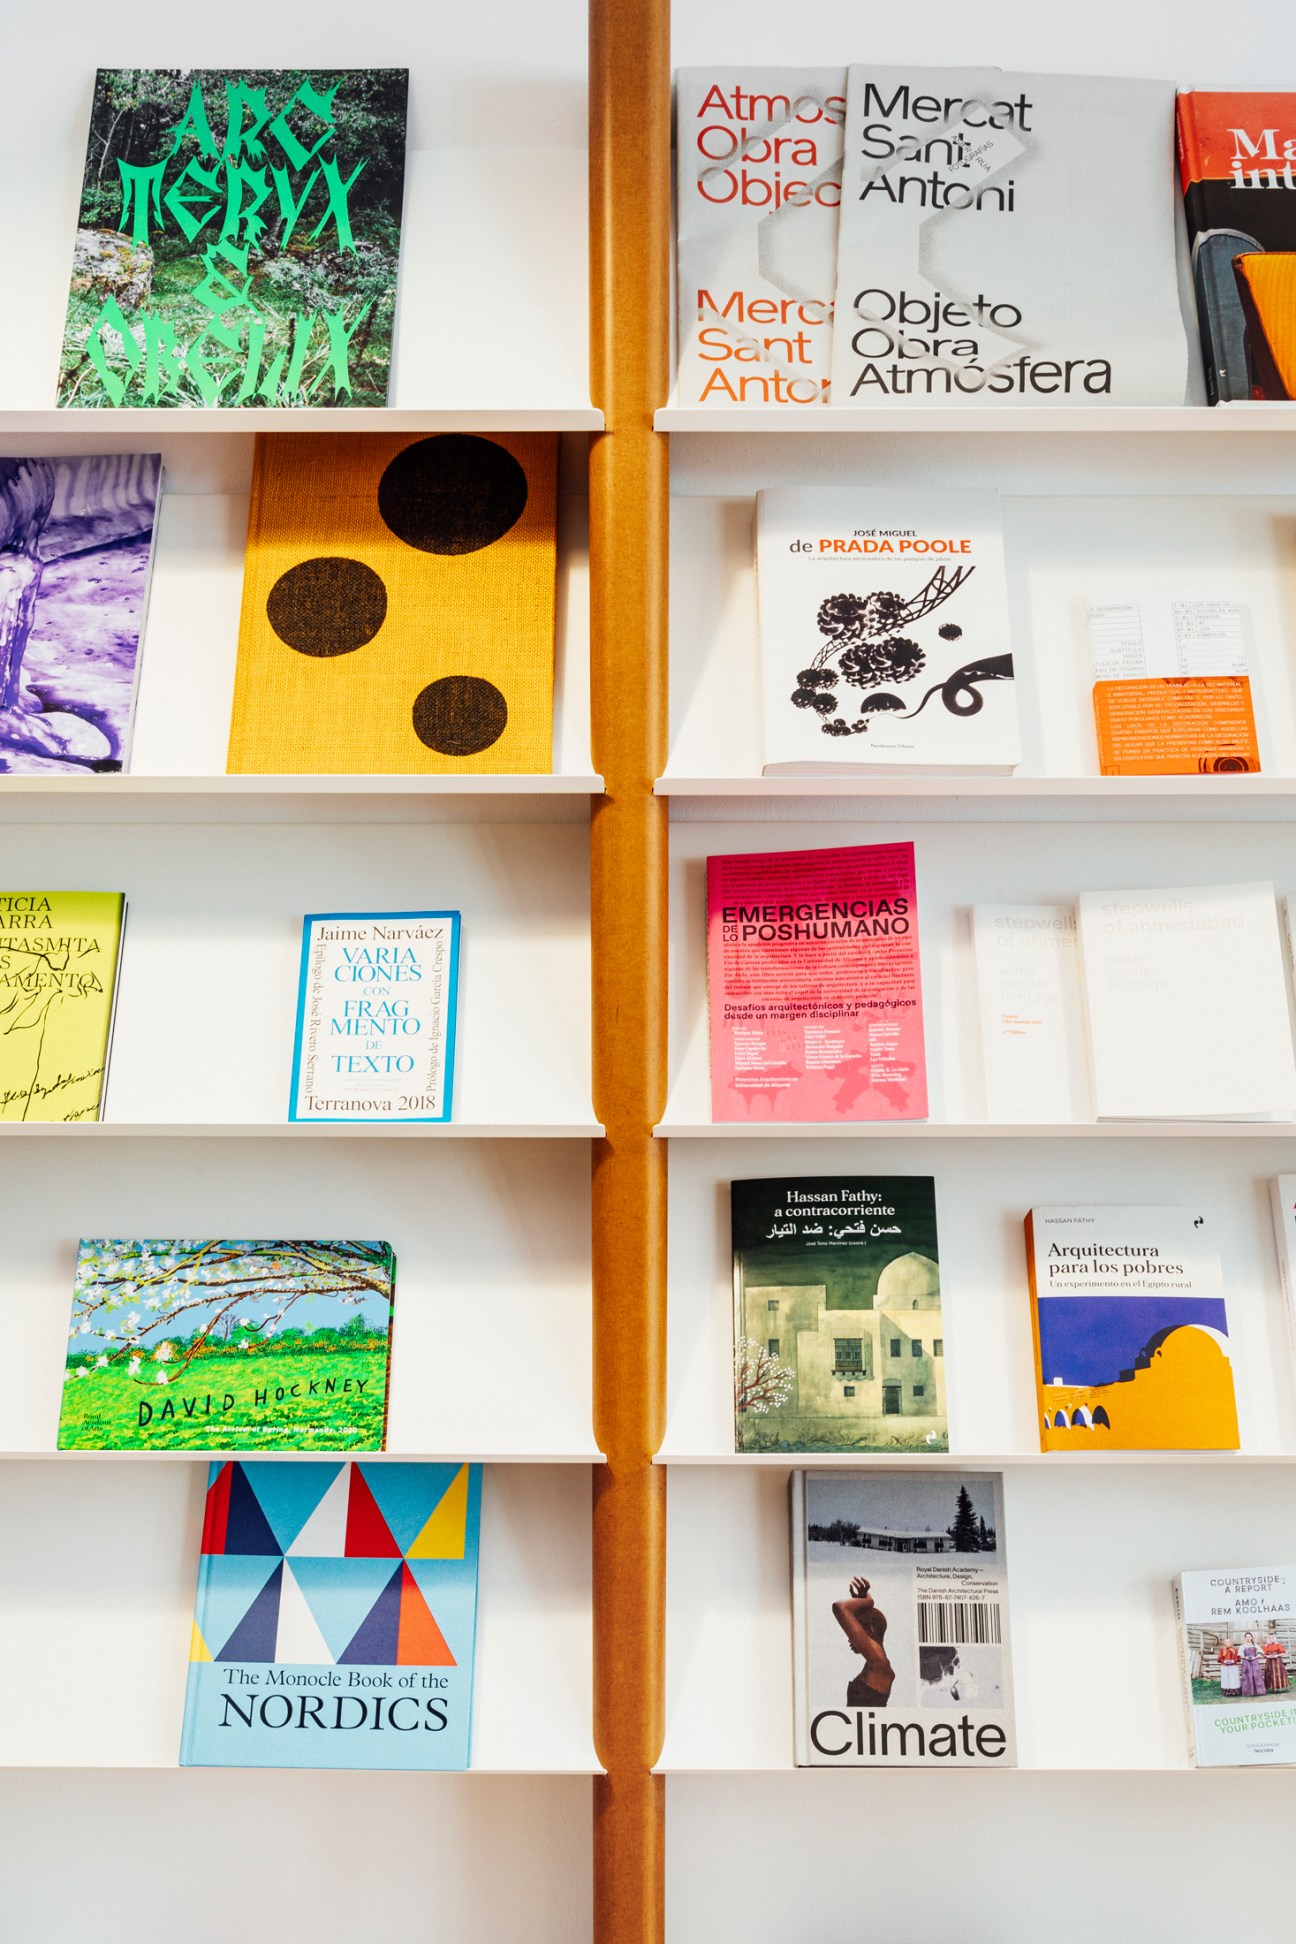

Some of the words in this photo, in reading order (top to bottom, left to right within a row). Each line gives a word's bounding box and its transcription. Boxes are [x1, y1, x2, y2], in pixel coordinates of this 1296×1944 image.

[697, 84, 847, 124] Atmos
[864, 83, 1033, 132] Mercat
[166, 78, 343, 172] ARC
[697, 125, 817, 166] Obra
[861, 124, 971, 167] Sant
[859, 166, 1014, 212] Antoni
[116, 153, 370, 257] TERYX
[854, 289, 1022, 333] Objeto
[697, 328, 812, 364] Sant
[852, 328, 979, 359] Obra
[850, 356, 1112, 397] Atmósfera
[853, 528, 876, 537] JOSÉ
[789, 539, 813, 553] de
[819, 539, 894, 553] PRADA
[900, 539, 972, 554] POOLE
[722, 898, 909, 923] EMERGENCIAS
[1101, 899, 1194, 917] stepwells
[317, 926, 367, 941] Jaime
[372, 924, 444, 941] Narváez
[722, 925, 738, 933] DE
[742, 917, 910, 942] POSHUMANO
[1103, 920, 1123, 934] of
[1129, 914, 1246, 934] ahmedabad
[722, 934, 738, 942] LO
[342, 947, 417, 964] VARIA
[432, 941, 446, 973] Crespo
[334, 965, 422, 982] CIONES
[312, 982, 324, 994] de
[363, 987, 390, 996] CON
[311, 995, 324, 1017] José
[343, 1000, 409, 1017] FRAG
[724, 1003, 767, 1012] Desafíos
[768, 1002, 844, 1013] arquitectónicos
[846, 1003, 852, 1011] y
[854, 999, 917, 1011] pedagógicos
[429, 1006, 442, 1041] Ignacio
[724, 1012, 753, 1020] desde
[770, 1012, 807, 1022] margen
[809, 1009, 860, 1020] disciplinar
[308, 1019, 321, 1053] Rivero
[330, 1018, 421, 1036] MENTO
[365, 1040, 383, 1050] DE
[428, 1042, 439, 1055] de
[331, 1055, 415, 1073] TEXTO
[305, 1054, 319, 1094] Serrano
[426, 1055, 441, 1092] Prólogo
[305, 1095, 391, 1111] Terranova
[398, 1095, 436, 1111] 2018
[787, 1191, 838, 1203] Hassan
[841, 1190, 882, 1205] Fathy:
[774, 1208, 782, 1217] a
[785, 1205, 896, 1217] contracorriente
[766, 1223, 797, 1239] التيار
[802, 1222, 823, 1235] ضد
[870, 1224, 902, 1237] حسن
[1048, 1243, 1160, 1261] Arquitectura
[1049, 1263, 1089, 1278] para
[1094, 1259, 1119, 1274] los
[1124, 1261, 1184, 1278] pobres
[1050, 1279, 1063, 1287] Un
[1064, 1280, 1119, 1289] experimento
[1133, 1279, 1141, 1287] el
[1142, 1280, 1170, 1289] Egipto
[1171, 1280, 1192, 1288] rural
[138, 1393, 235, 1427] DAVID
[254, 1377, 369, 1407] HOCKNEY
[1235, 1584, 1272, 1593] REPORT
[1235, 1598, 1258, 1607] AMO
[1236, 1604, 1290, 1614] KOOLHAAS
[223, 1667, 260, 1685] The
[265, 1669, 342, 1687] Monocle
[348, 1671, 393, 1688] Book
[398, 1672, 418, 1688] of
[421, 1673, 449, 1689] the
[218, 1693, 448, 1732] NORDICS
[1214, 1709, 1287, 1727] COUNTRYSIDE
[810, 1710, 1006, 1758] Climate
[1220, 1723, 1249, 1734] YOUR
